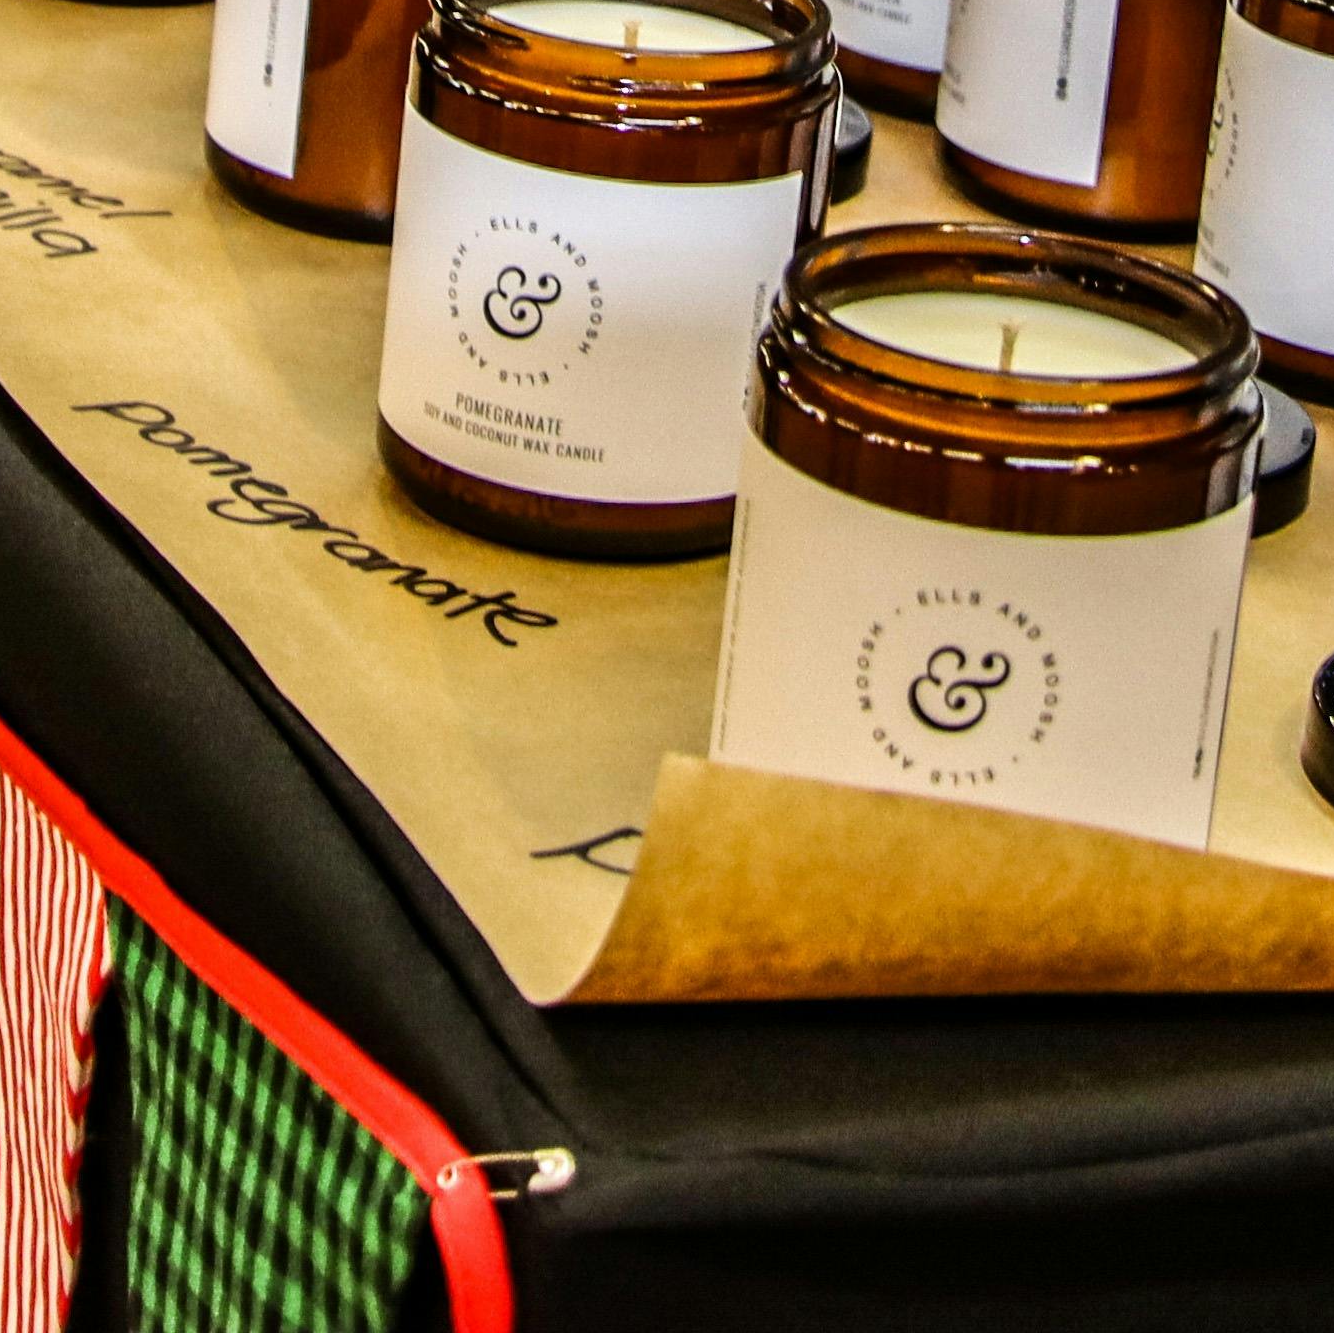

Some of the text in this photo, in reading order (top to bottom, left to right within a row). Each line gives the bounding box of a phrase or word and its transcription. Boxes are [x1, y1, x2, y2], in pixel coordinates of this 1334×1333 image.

[448, 243, 550, 386] ELLS AND MOOSH
[483, 265, 562, 340] &
[489, 217, 604, 355] ELLS AND MOOSH
[423, 399, 605, 465] SOY AND COCONUT WAX CANDLE
[455, 391, 564, 437] POMEGRANATE
[856, 621, 995, 786] ELLS AND MOOSH
[908, 645, 1011, 732] &
[917, 589, 1059, 744] ELLS AND MOOSH
